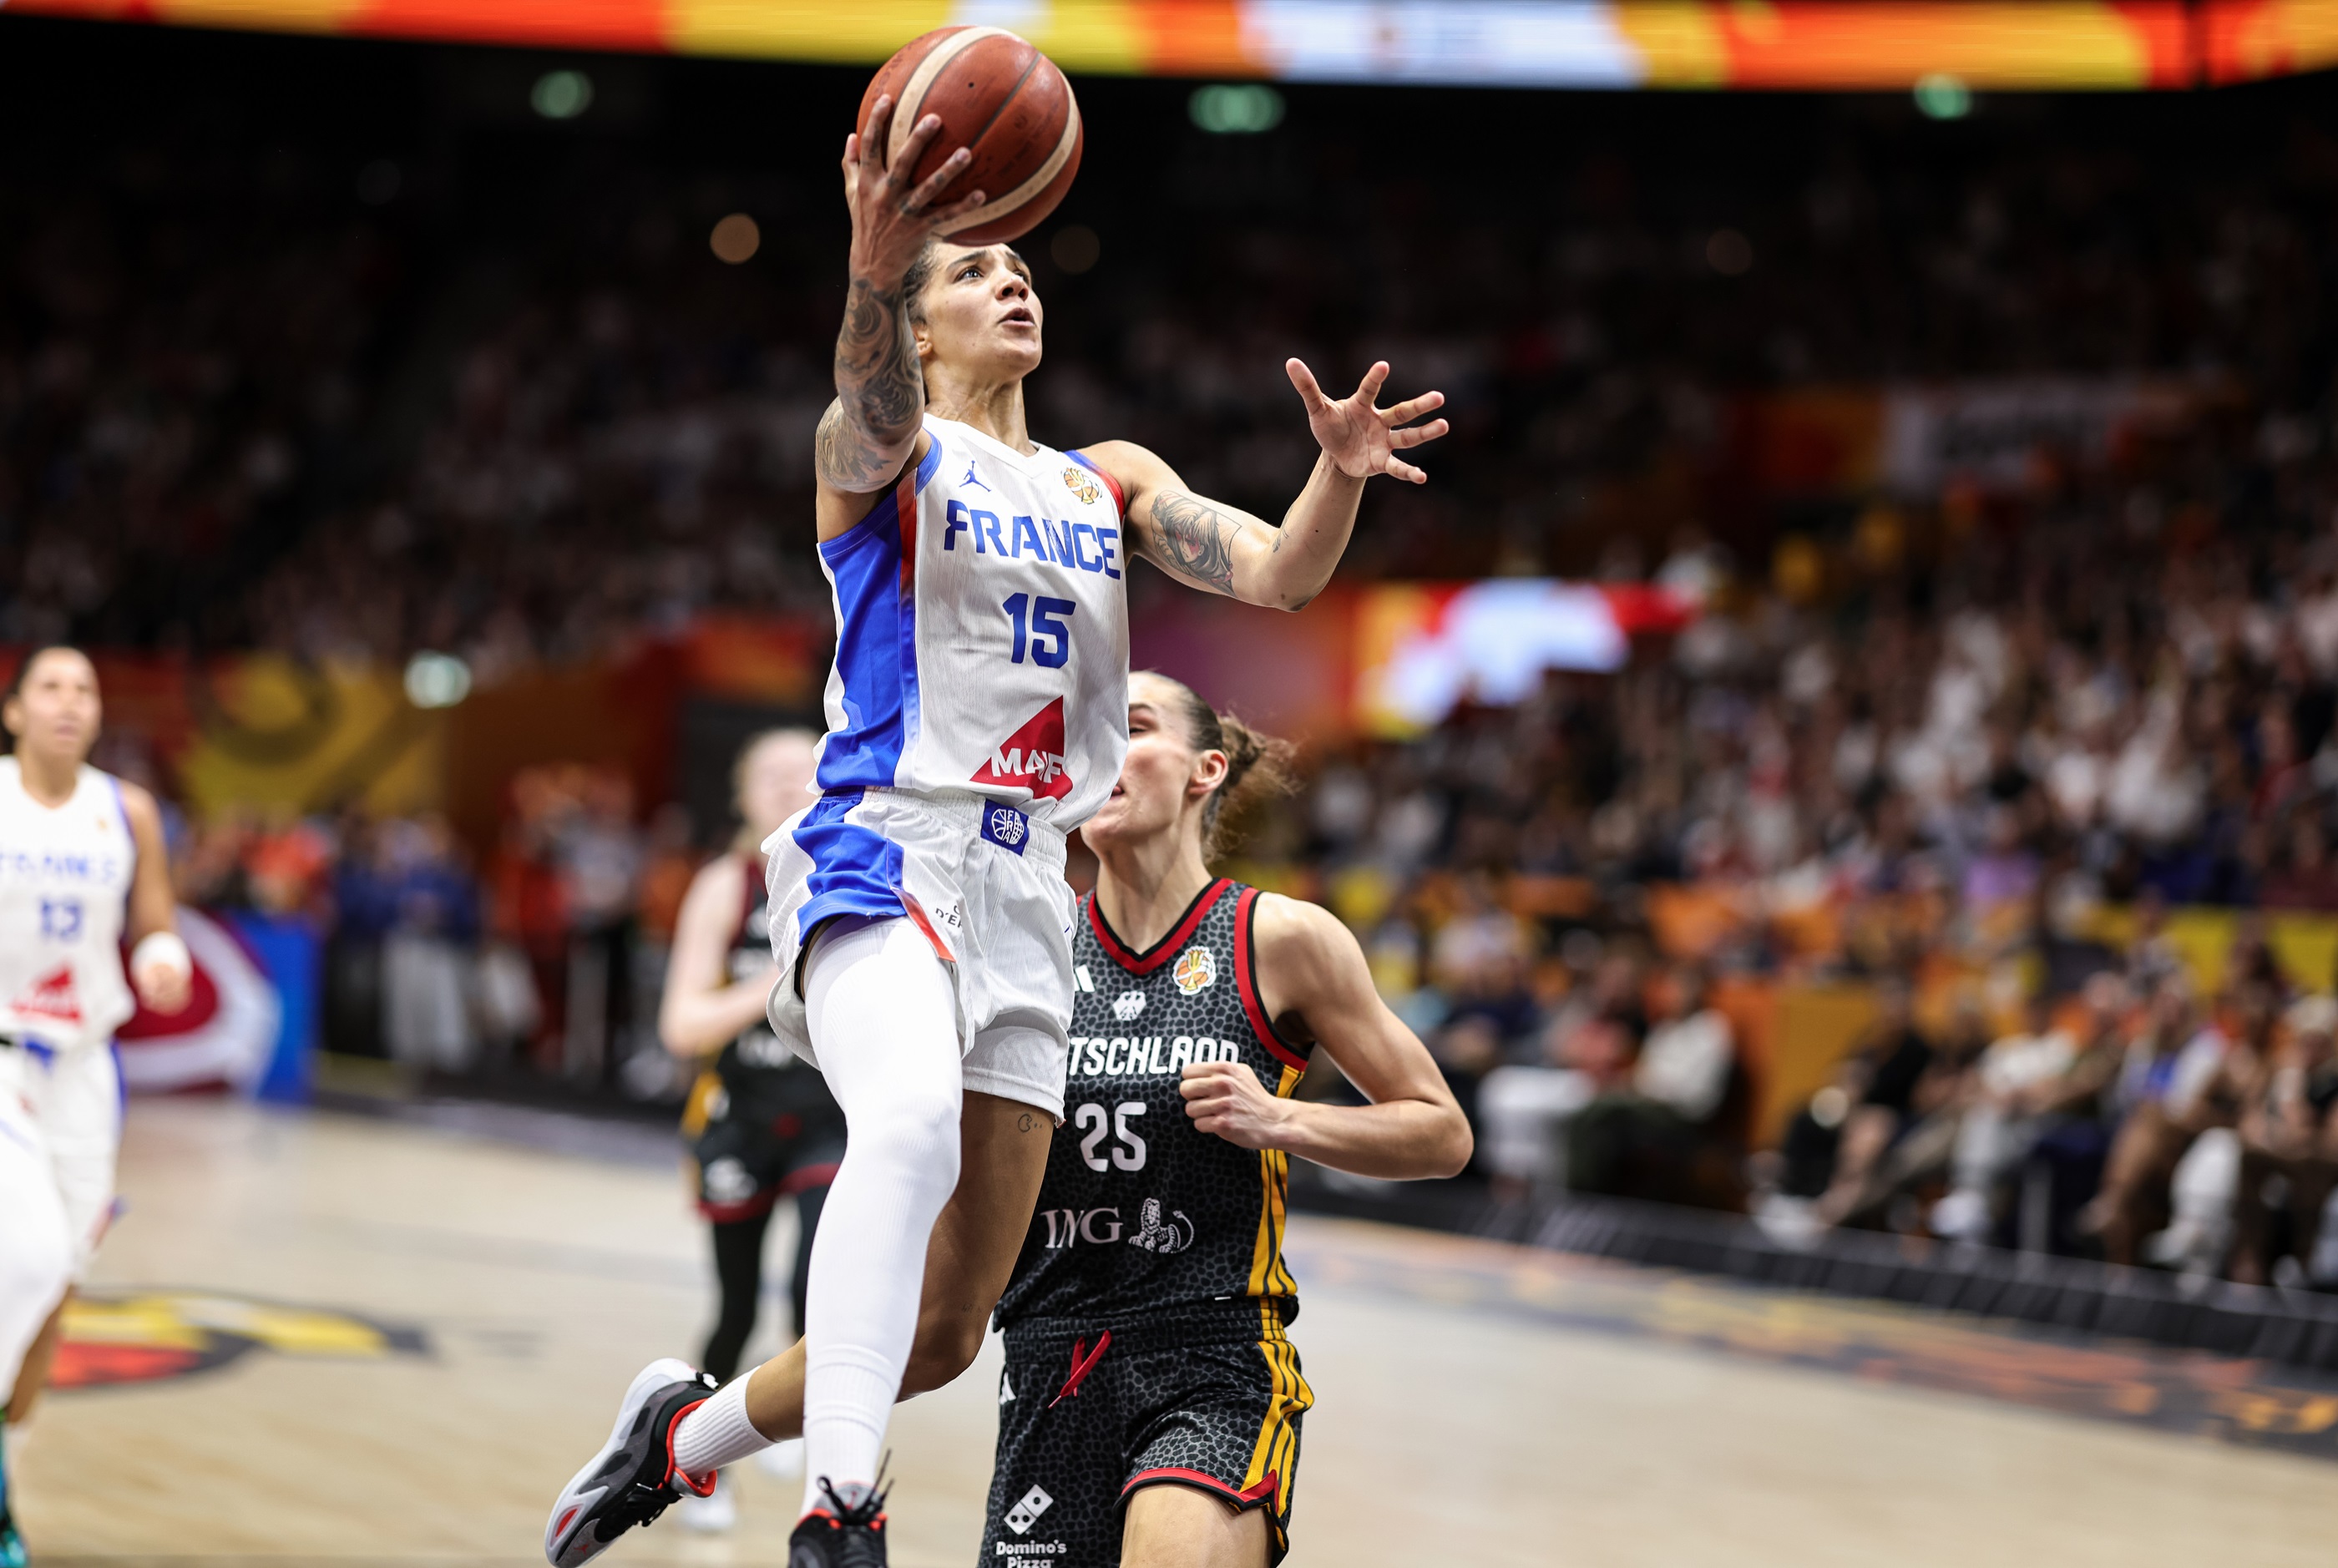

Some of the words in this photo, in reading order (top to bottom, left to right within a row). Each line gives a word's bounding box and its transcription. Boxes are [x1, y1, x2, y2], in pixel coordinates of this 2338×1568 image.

[944, 499, 1121, 579] FRANCE
[1002, 592, 1076, 669] 15
[1069, 1035, 1240, 1076] TSCHLAND
[1075, 1101, 1147, 1172] 25
[1040, 1206, 1124, 1249] ING
[995, 1539, 1067, 1555] Domino's
[1007, 1555, 1052, 1568] Pizza
